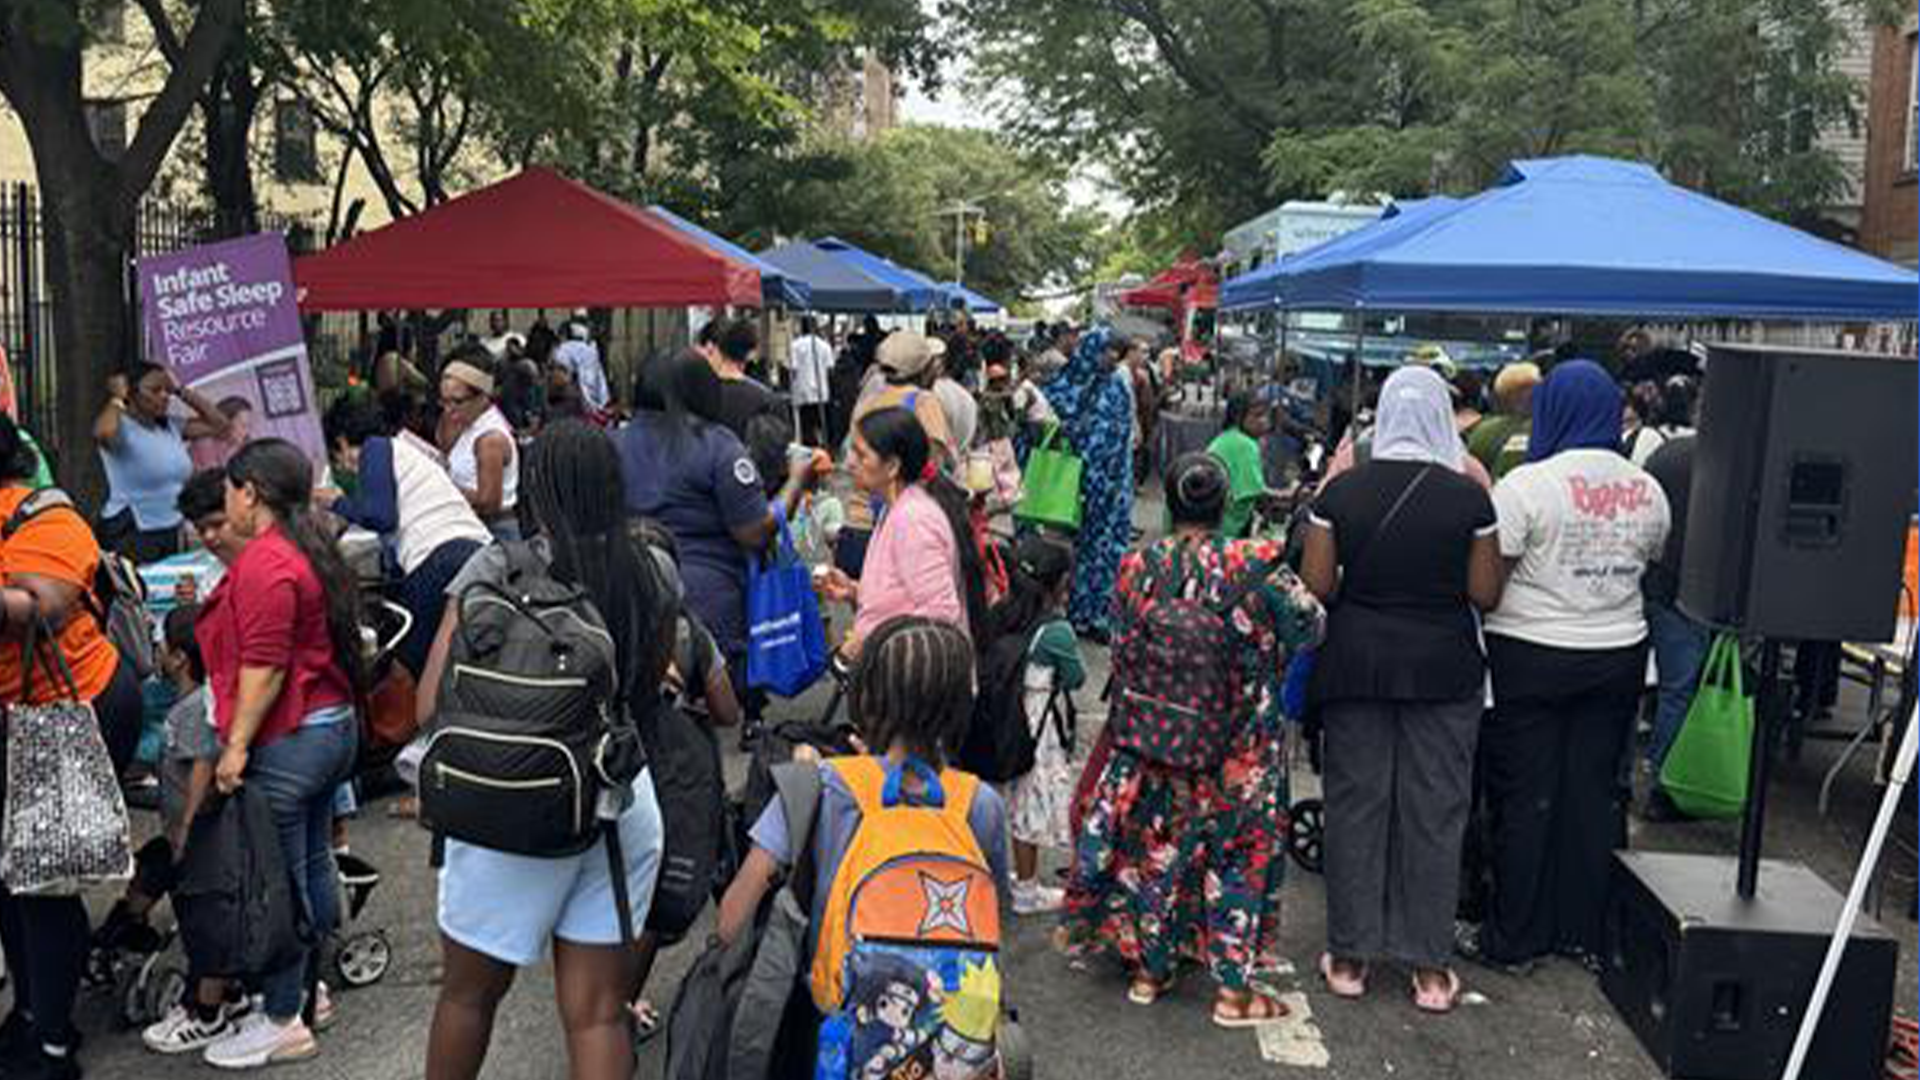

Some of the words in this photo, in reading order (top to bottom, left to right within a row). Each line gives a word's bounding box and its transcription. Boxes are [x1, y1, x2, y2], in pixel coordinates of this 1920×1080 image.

[153, 262, 229, 296] Infant
[157, 293, 214, 319] Safe
[216, 281, 283, 309] Sleep
[163, 309, 266, 344] Resource
[167, 342, 208, 366] Fair
